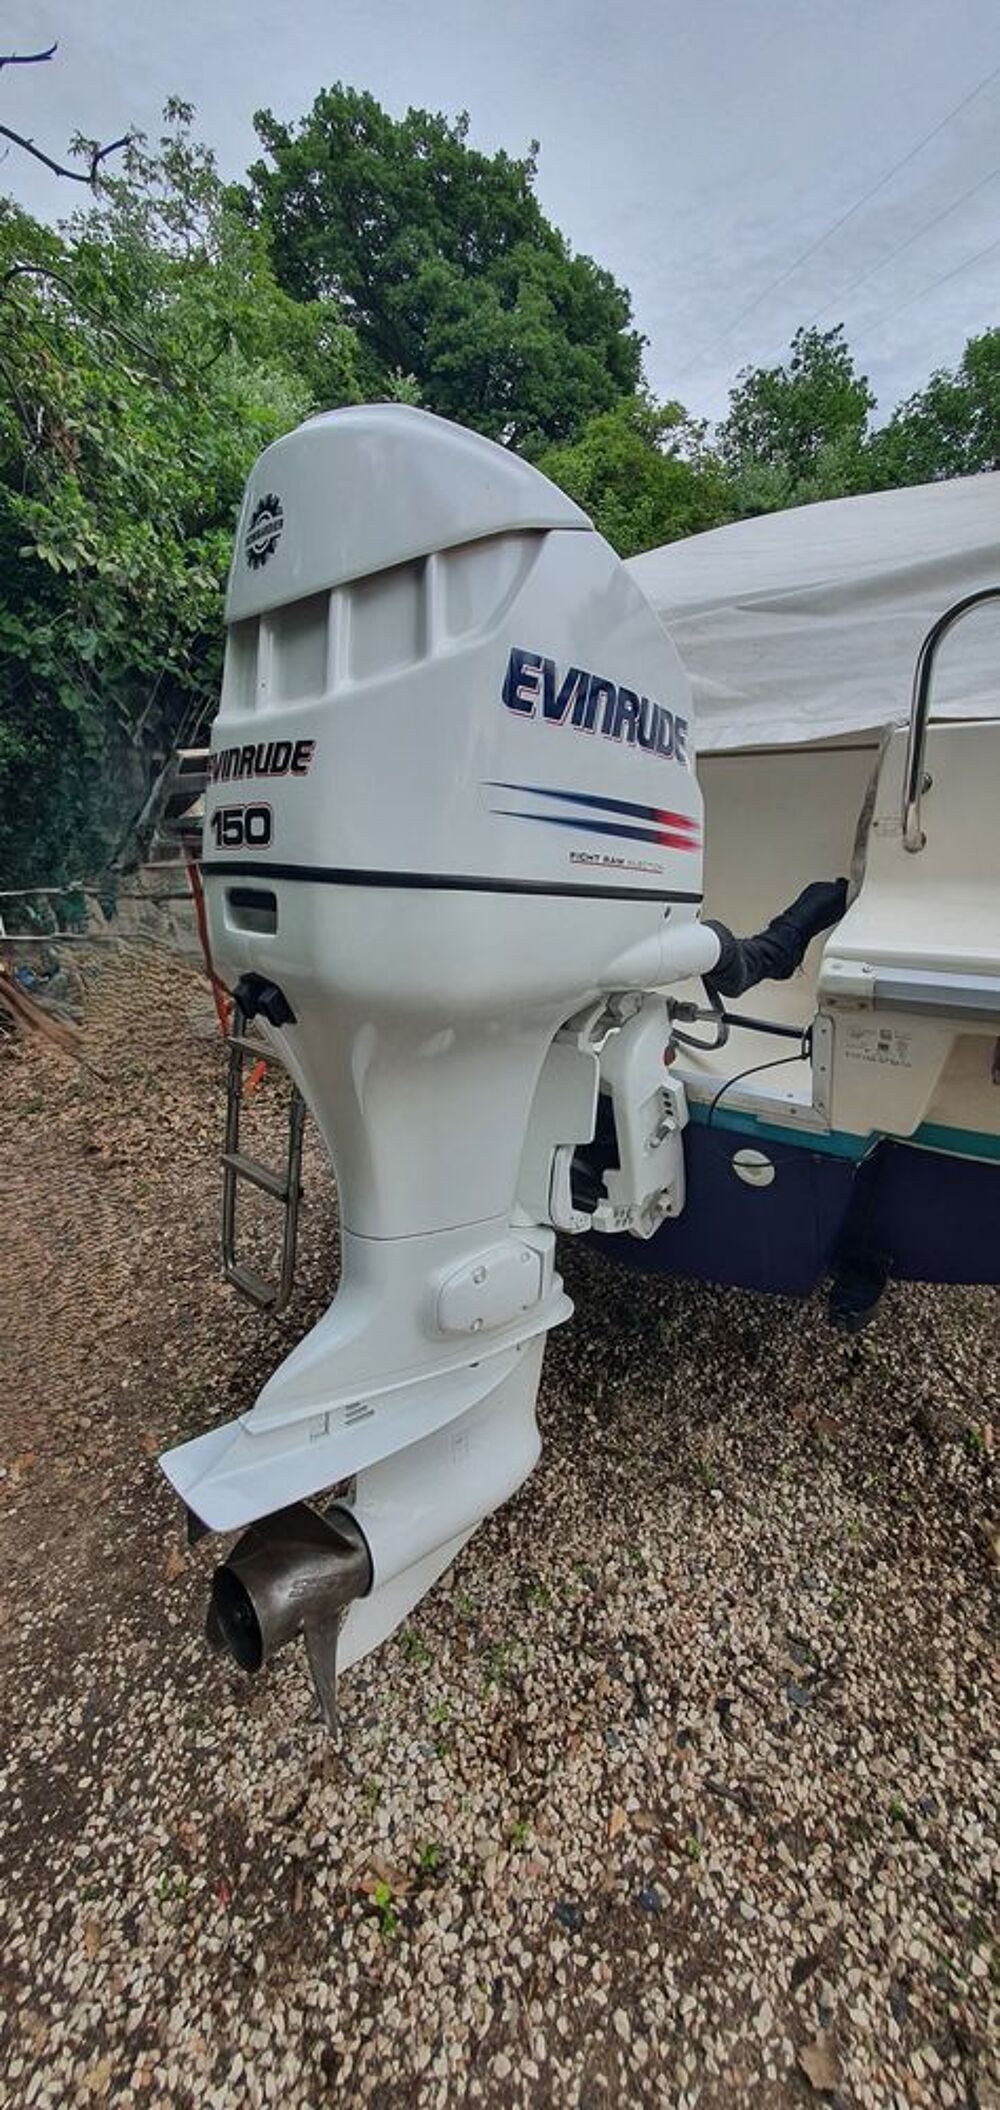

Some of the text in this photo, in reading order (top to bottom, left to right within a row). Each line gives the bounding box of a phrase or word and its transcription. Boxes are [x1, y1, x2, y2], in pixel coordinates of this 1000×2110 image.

[502, 647, 688, 766] EVINRUDE
[208, 740, 315, 783] VINRUDE
[211, 802, 271, 850] 150
